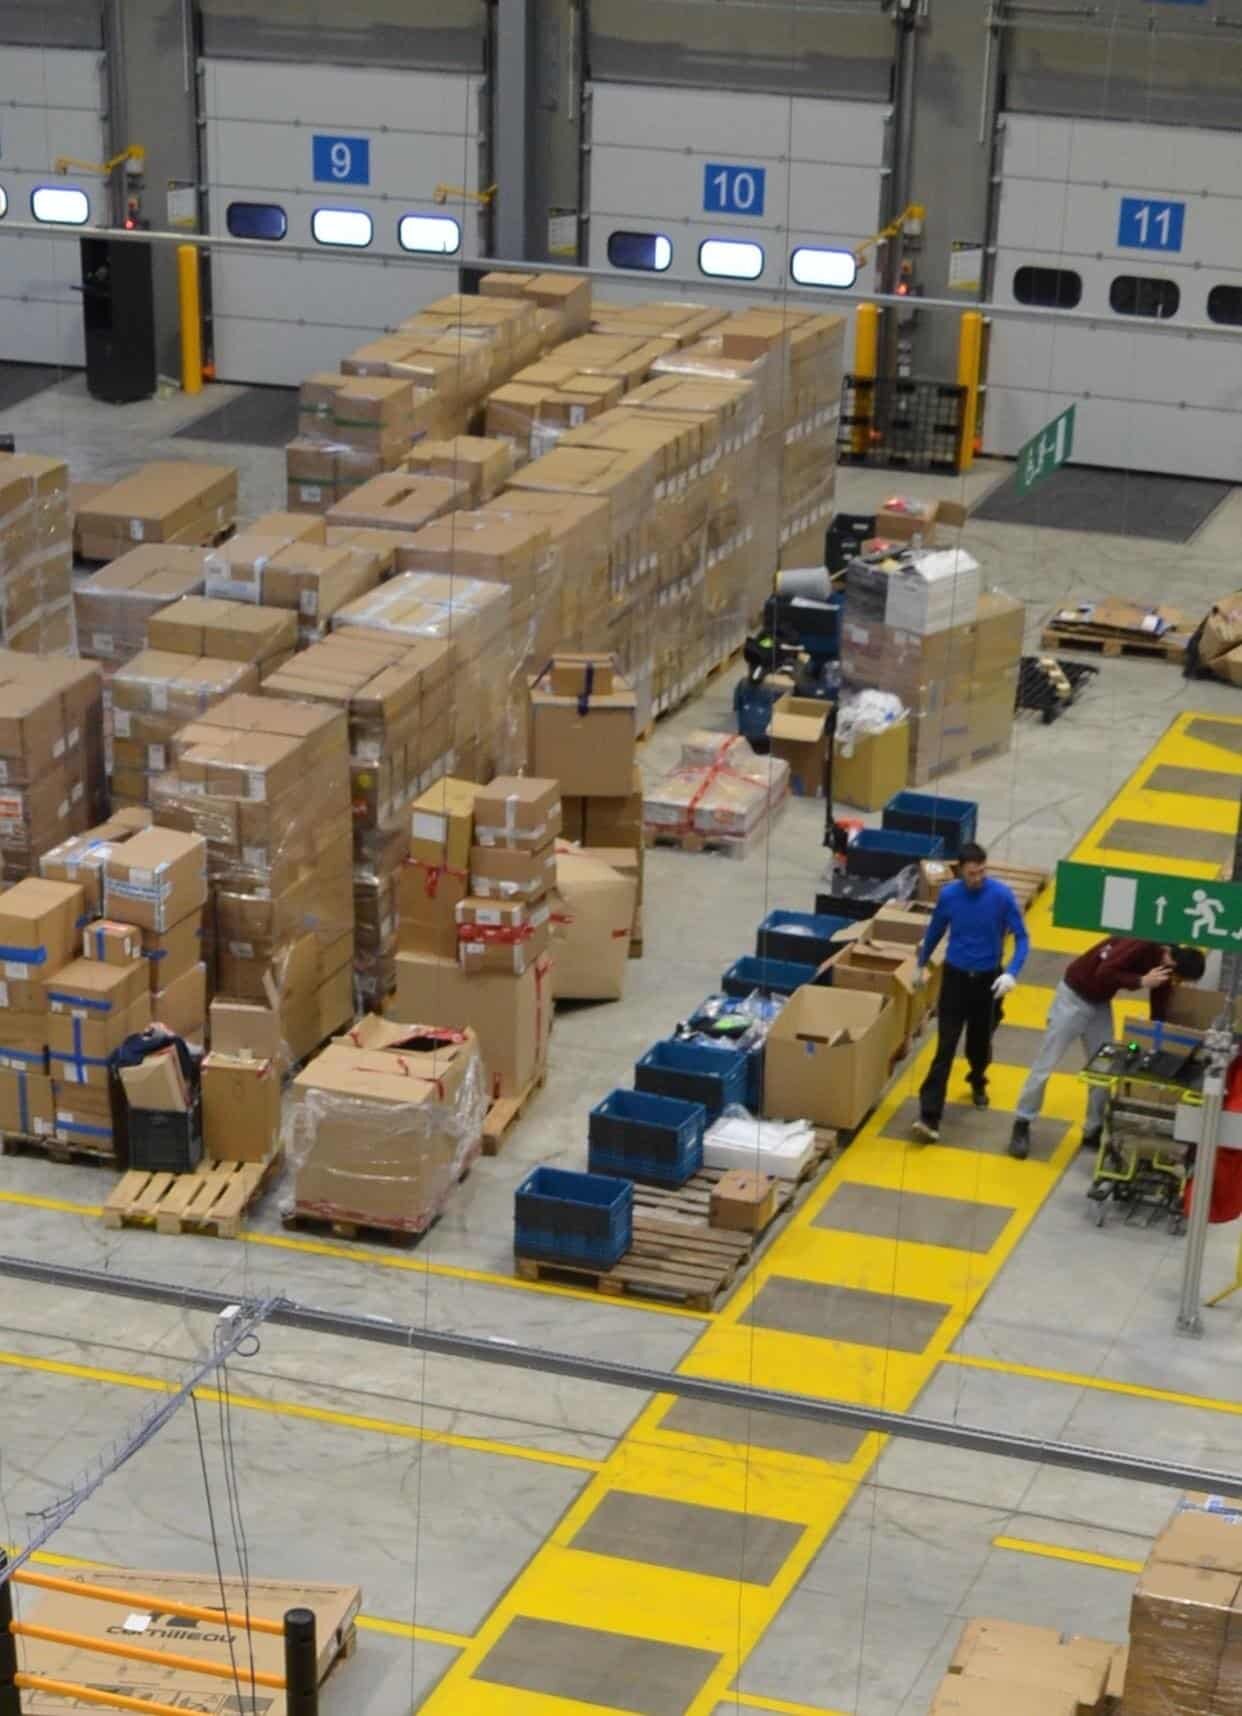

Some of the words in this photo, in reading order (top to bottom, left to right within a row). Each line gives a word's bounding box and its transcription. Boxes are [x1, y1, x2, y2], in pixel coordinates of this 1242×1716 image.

[331, 142, 351, 178] 9
[712, 171, 755, 209] 10
[1134, 206, 1171, 245] 11
